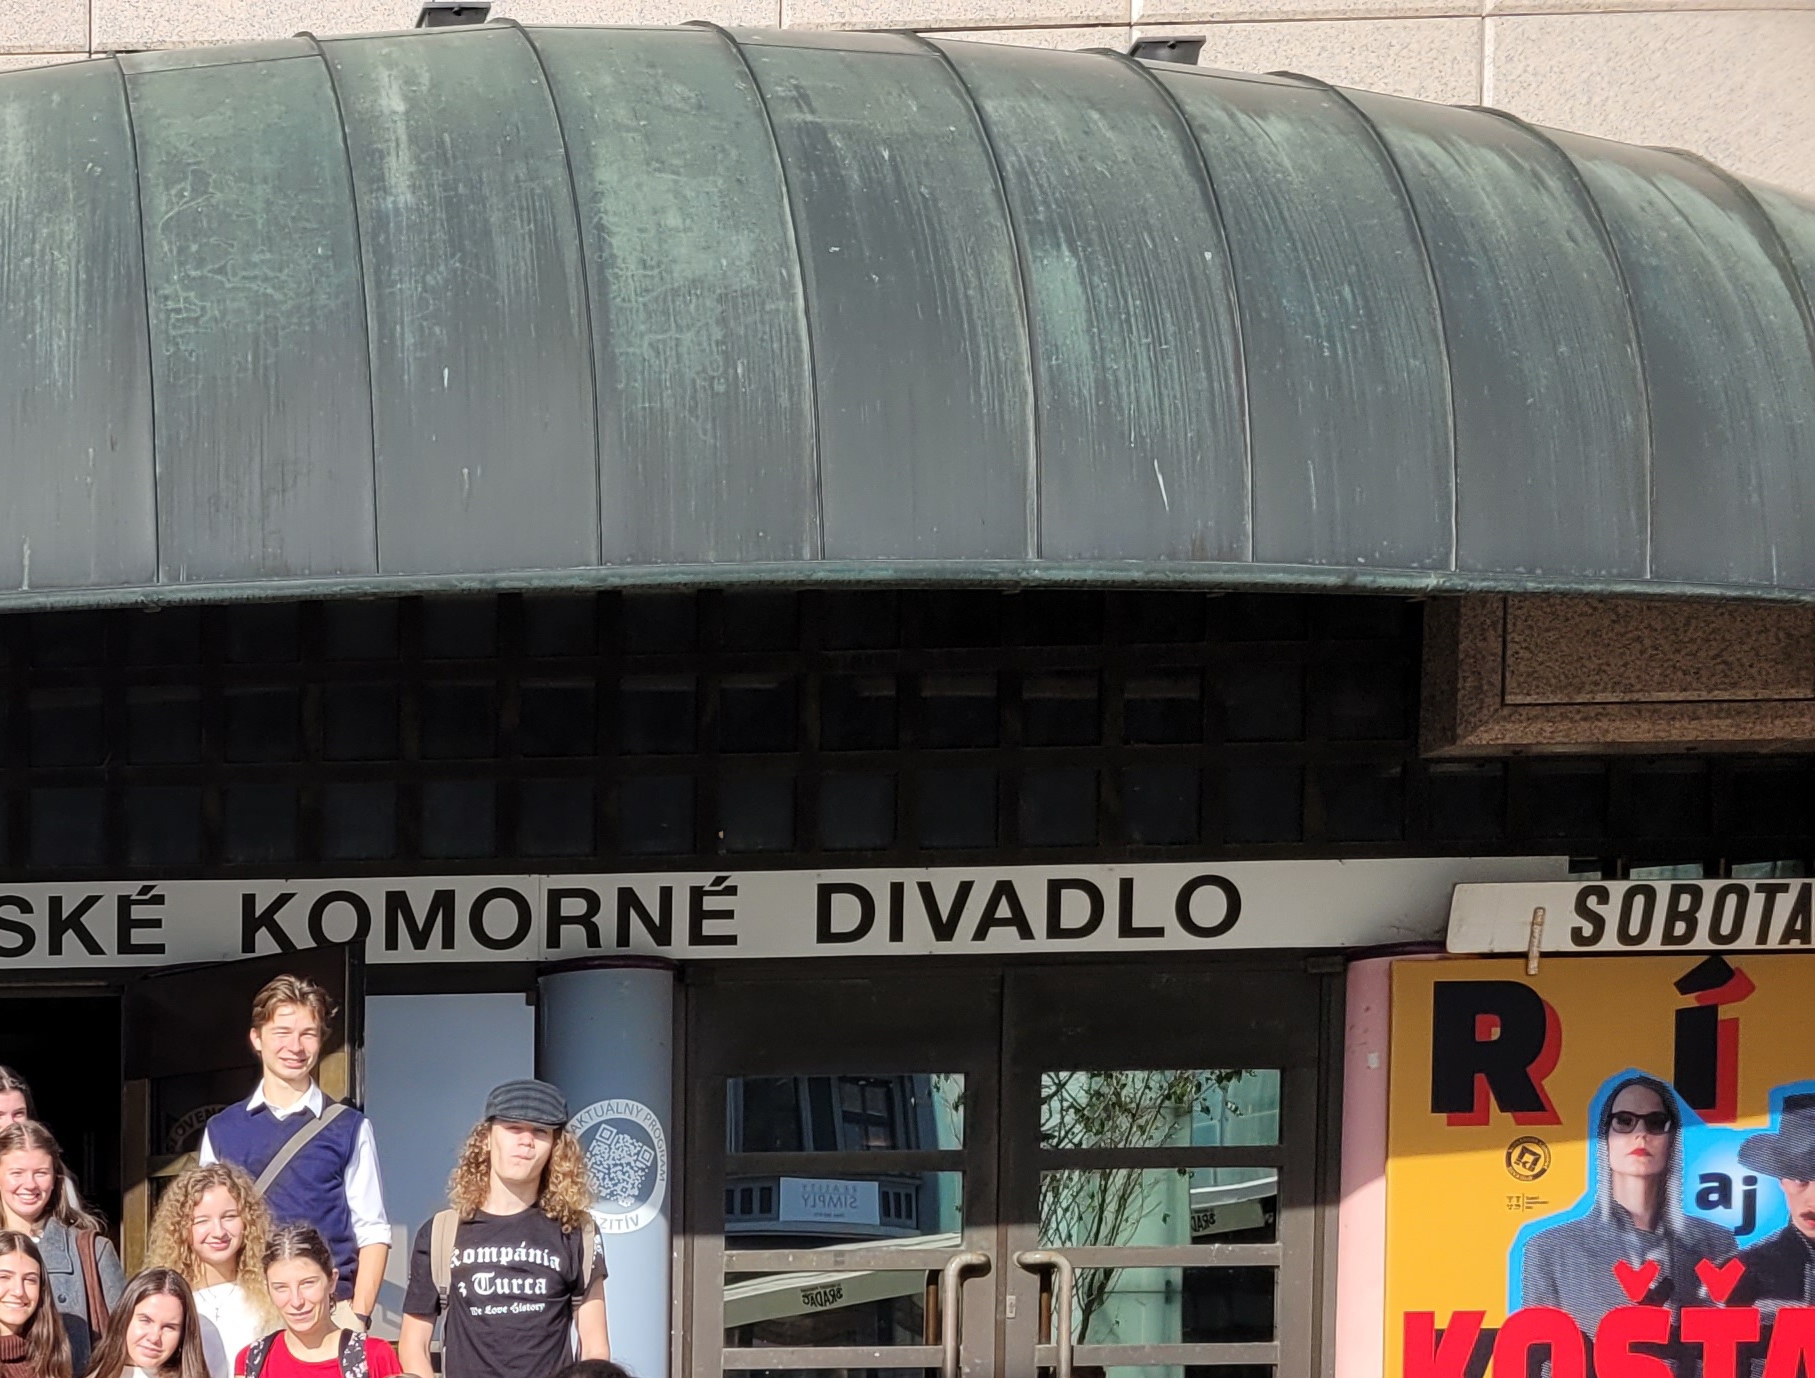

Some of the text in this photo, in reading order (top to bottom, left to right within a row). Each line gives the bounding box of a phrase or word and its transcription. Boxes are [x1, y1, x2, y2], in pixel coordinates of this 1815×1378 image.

[241, 876, 738, 953] KOMORNÉ
[816, 874, 1242, 945] DIVADLO
[1570, 883, 1813, 947] SOBOTA
[570, 1101, 643, 1135] AKTUÁLNY
[596, 1213, 639, 1231] ZITÍV
[1696, 1172, 1758, 1236] aj
[471, 1271, 547, 1295] Turca
